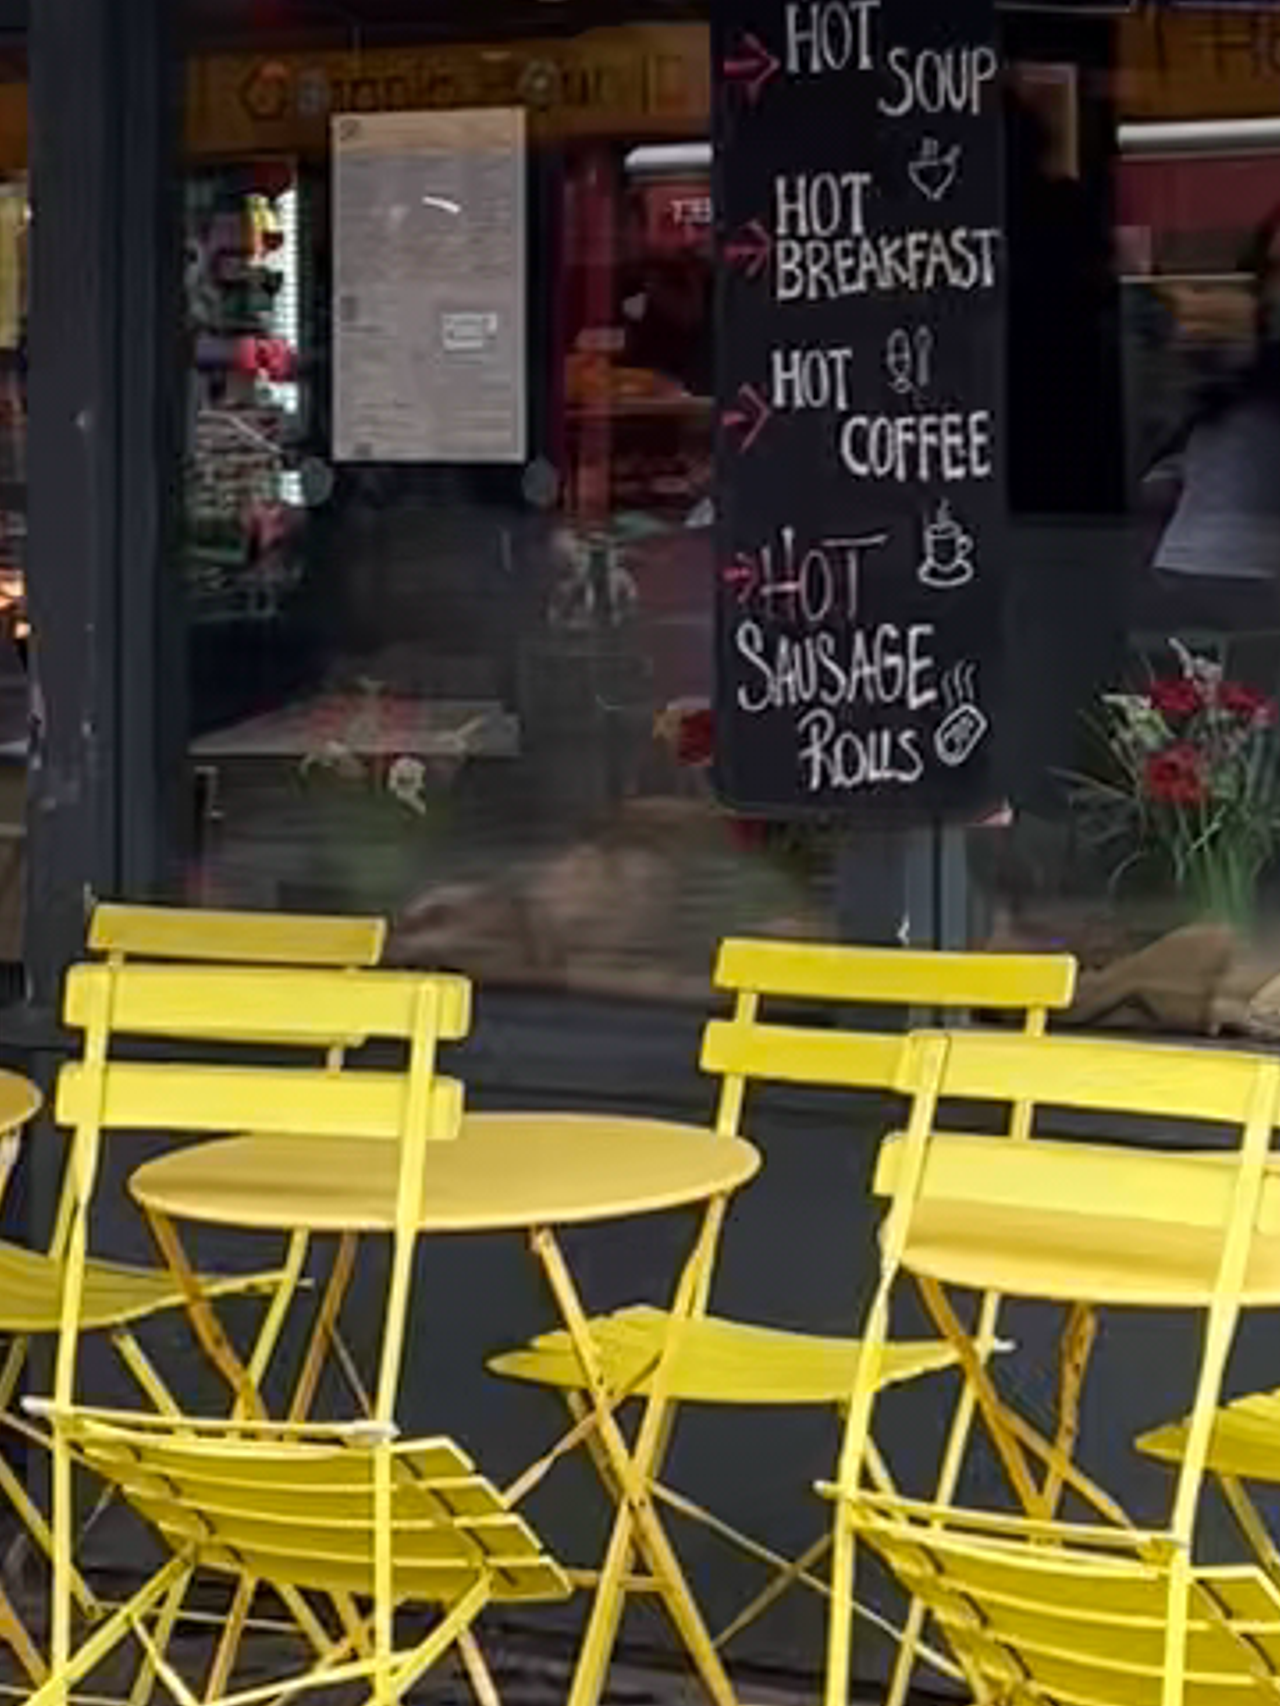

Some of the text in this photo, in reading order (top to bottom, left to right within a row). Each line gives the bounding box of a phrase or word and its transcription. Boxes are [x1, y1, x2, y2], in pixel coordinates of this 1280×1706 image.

[876, 45, 998, 117] SOUP
[774, 172, 872, 238] HOT
[774, 227, 1001, 303] BREAKFAST
[771, 347, 854, 411] HOT
[840, 410, 992, 482] COFFEE
[758, 526, 889, 623] HOT
[736, 618, 938, 714] SAUSAGE
[797, 707, 925, 791] ROLLS
